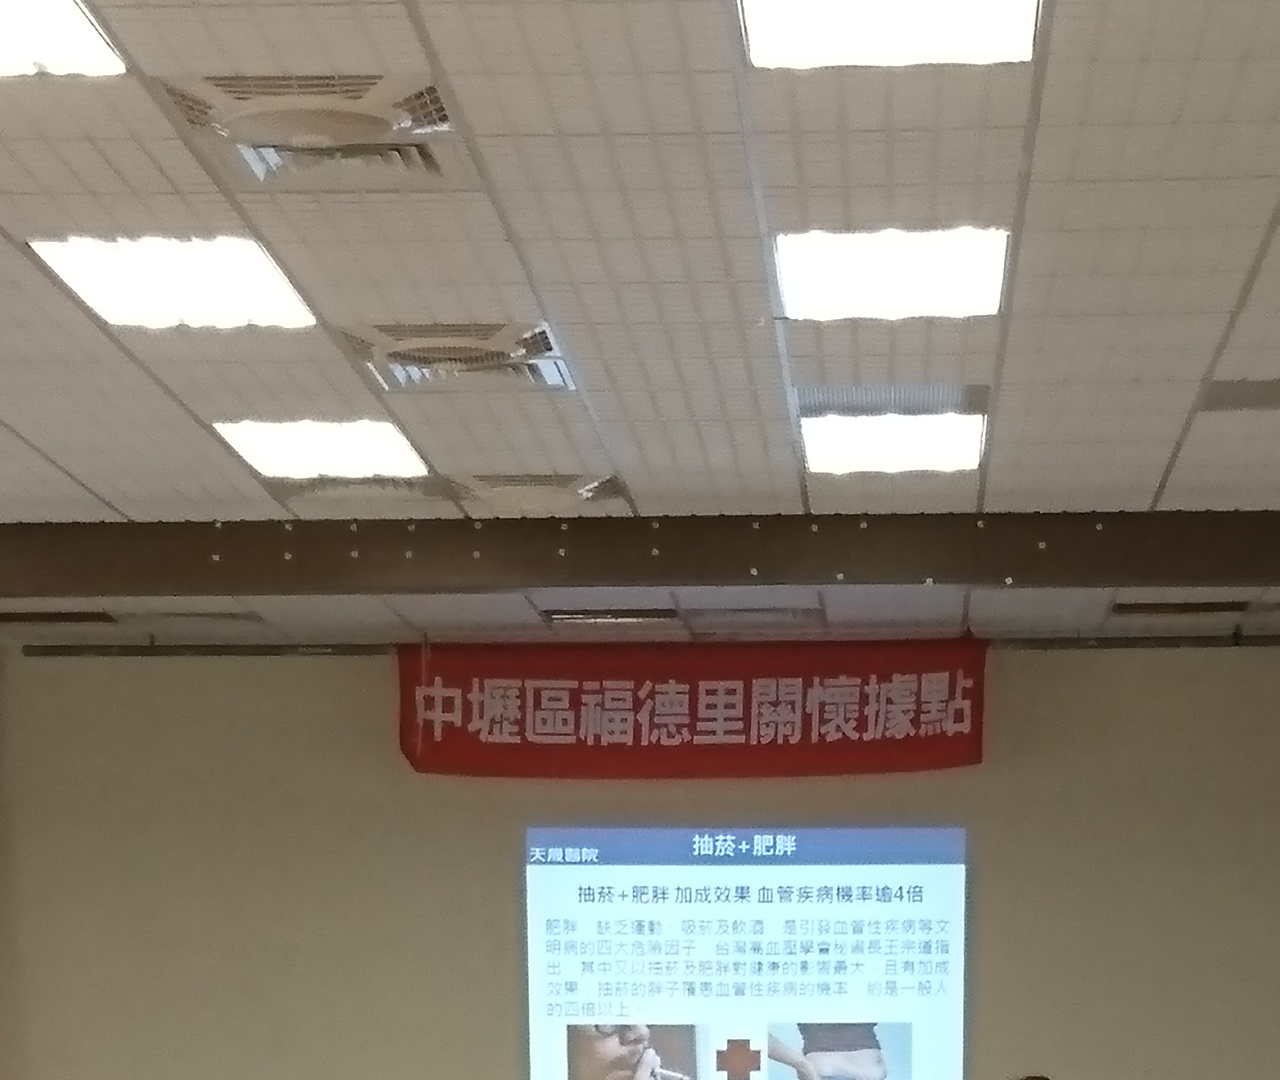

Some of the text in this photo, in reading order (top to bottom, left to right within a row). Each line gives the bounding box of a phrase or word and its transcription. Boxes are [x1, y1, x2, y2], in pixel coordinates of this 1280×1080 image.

[414, 668, 975, 747] 中壢區福德里關懷據點
[692, 833, 797, 857] 抽菸+肥胖
[577, 885, 924, 904] 抽菸+肥胖 加成效果 血管疾病機率逾4倍
